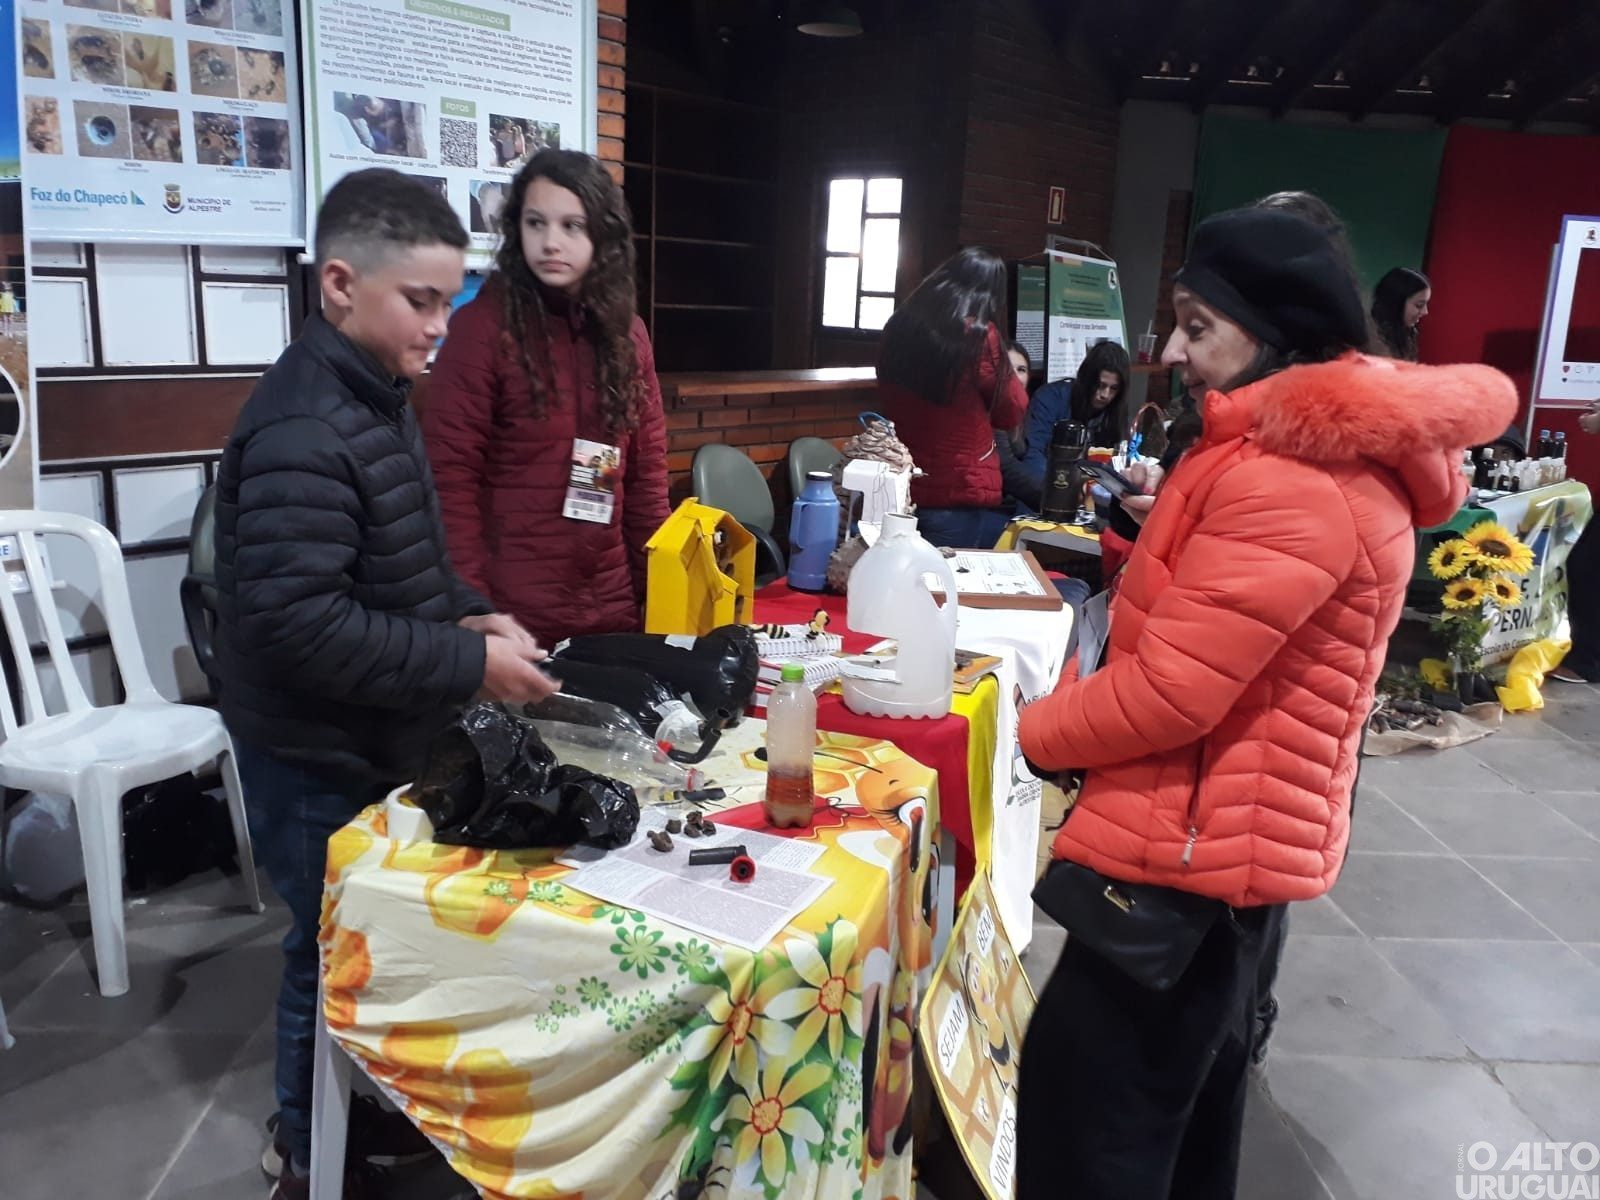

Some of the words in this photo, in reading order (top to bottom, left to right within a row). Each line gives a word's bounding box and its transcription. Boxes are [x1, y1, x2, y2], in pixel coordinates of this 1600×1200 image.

[446, 102, 469, 113] FOTOS
[30, 187, 52, 201] Foz
[55, 189, 71, 202] do
[74, 189, 127, 206] Chapecó
[188, 204, 222, 212] ALPESTRE
[939, 1000, 965, 1068] SEJAM
[993, 1115, 1017, 1192] VINDOS
